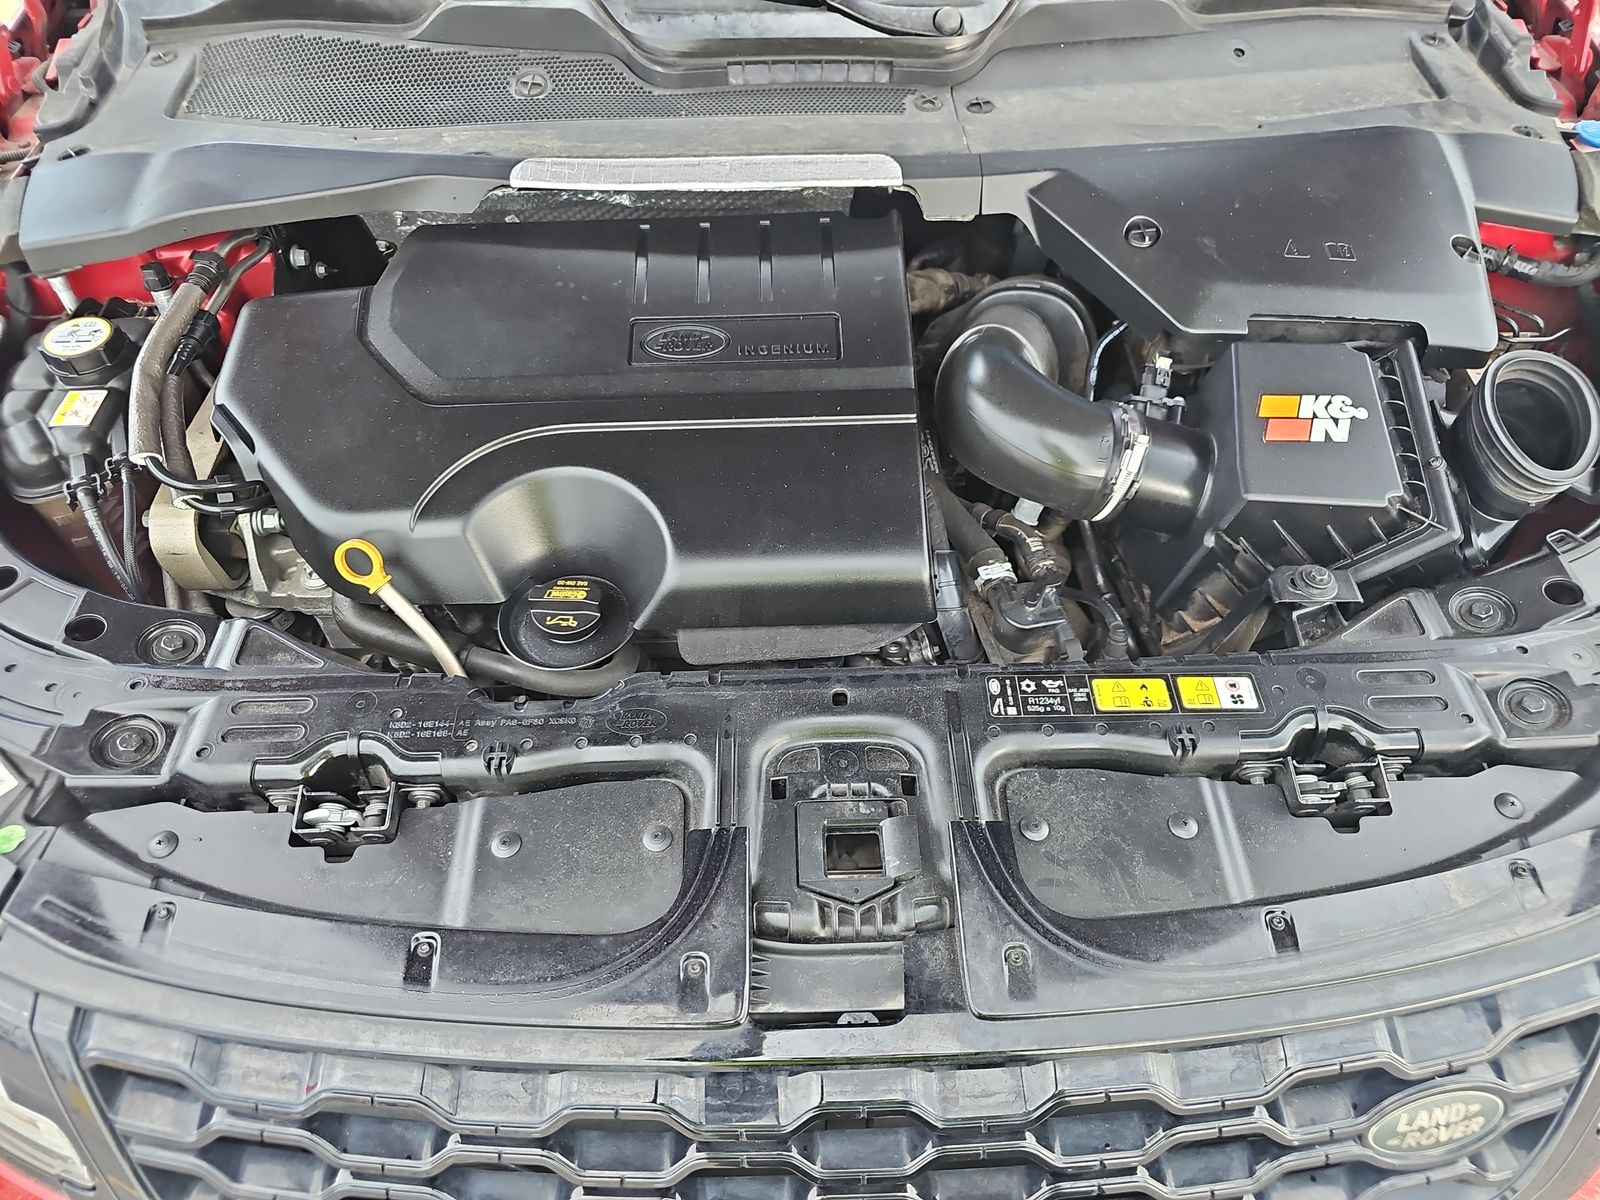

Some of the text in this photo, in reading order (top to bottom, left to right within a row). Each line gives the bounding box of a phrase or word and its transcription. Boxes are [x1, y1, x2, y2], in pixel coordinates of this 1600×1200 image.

[662, 341, 714, 352] ROVER
[737, 343, 830, 356] INGENIUM
[1028, 697, 1062, 706] R1234yf
[1397, 1102, 1467, 1133] LAND
[1400, 1115, 1486, 1149] ROVER
